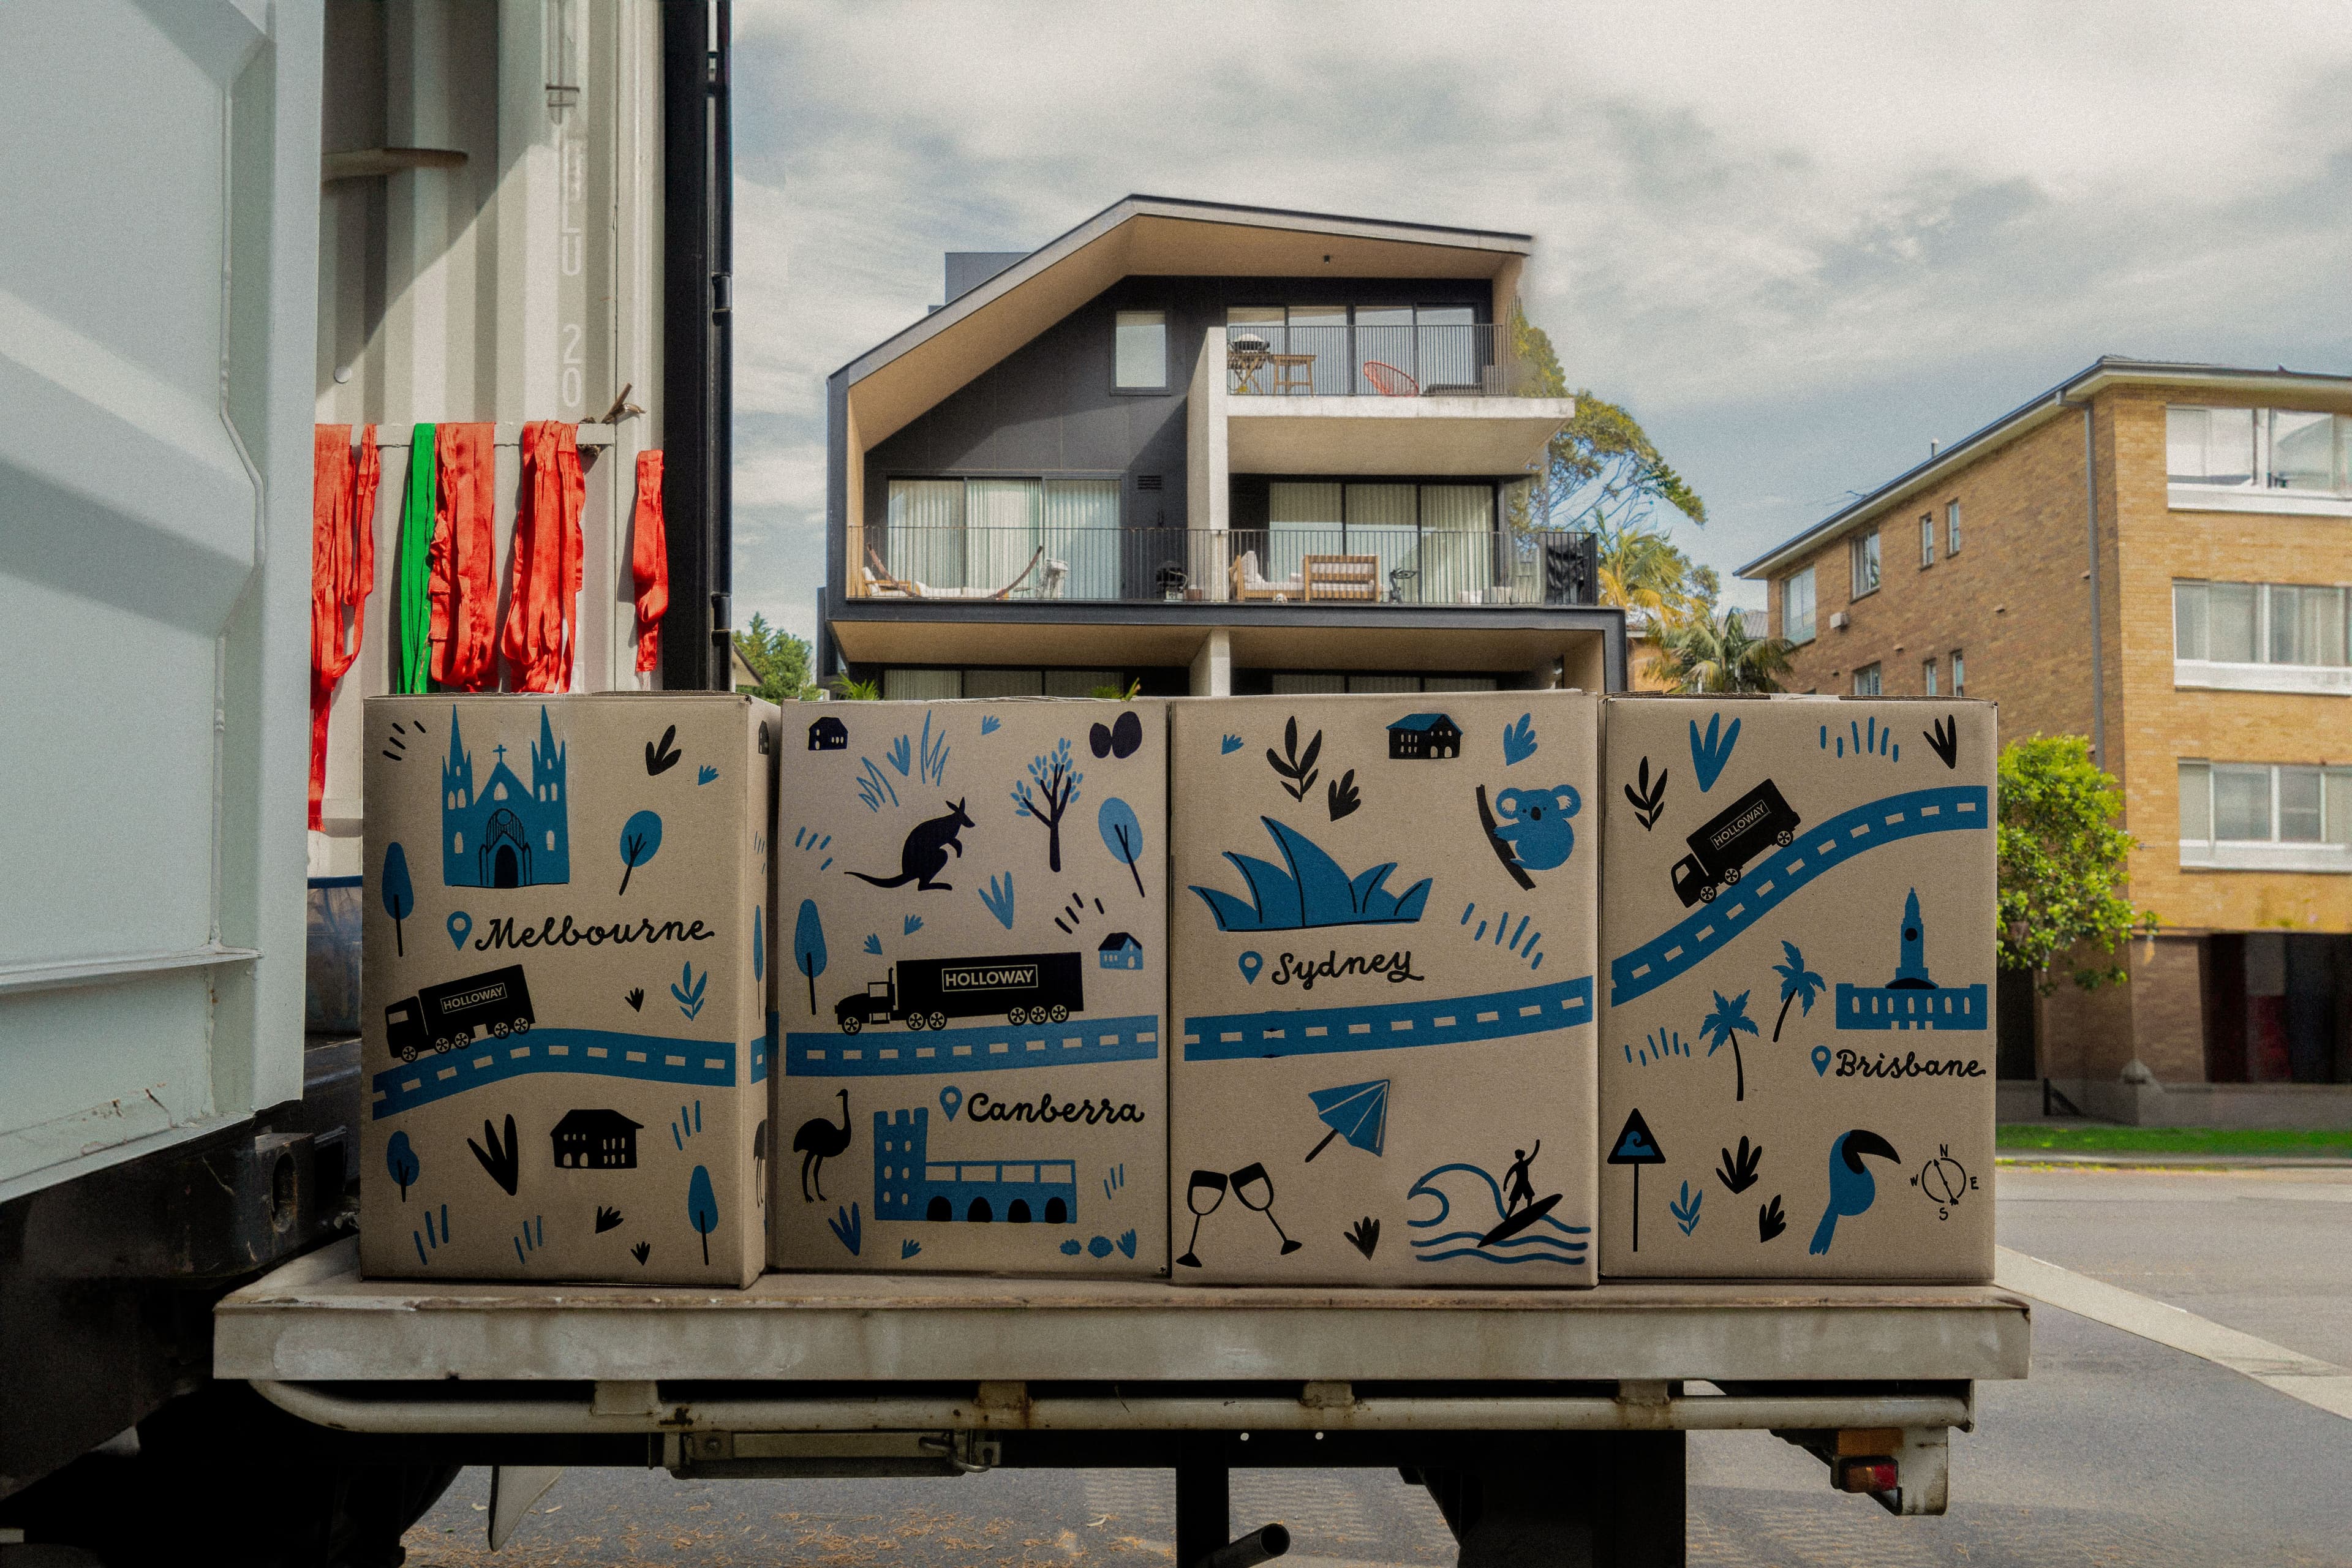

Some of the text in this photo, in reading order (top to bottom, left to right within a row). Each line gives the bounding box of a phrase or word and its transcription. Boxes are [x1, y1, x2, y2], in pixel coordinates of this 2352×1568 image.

[1714, 804, 1765, 846] HOLLOWAY
[474, 915, 715, 952] Melbourne
[945, 969, 1035, 987] HOLLOWAY
[1271, 950, 1425, 990] Sydney
[443, 986, 503, 1010] HOLLOWAY
[1836, 1049, 1987, 1079] Brisbane
[967, 1091, 1145, 1126] Canberra
[1939, 1144, 1948, 1158] N
[1910, 1173, 1919, 1187] W
[1969, 1176, 1980, 1190] E
[1939, 1207, 1949, 1221] S
